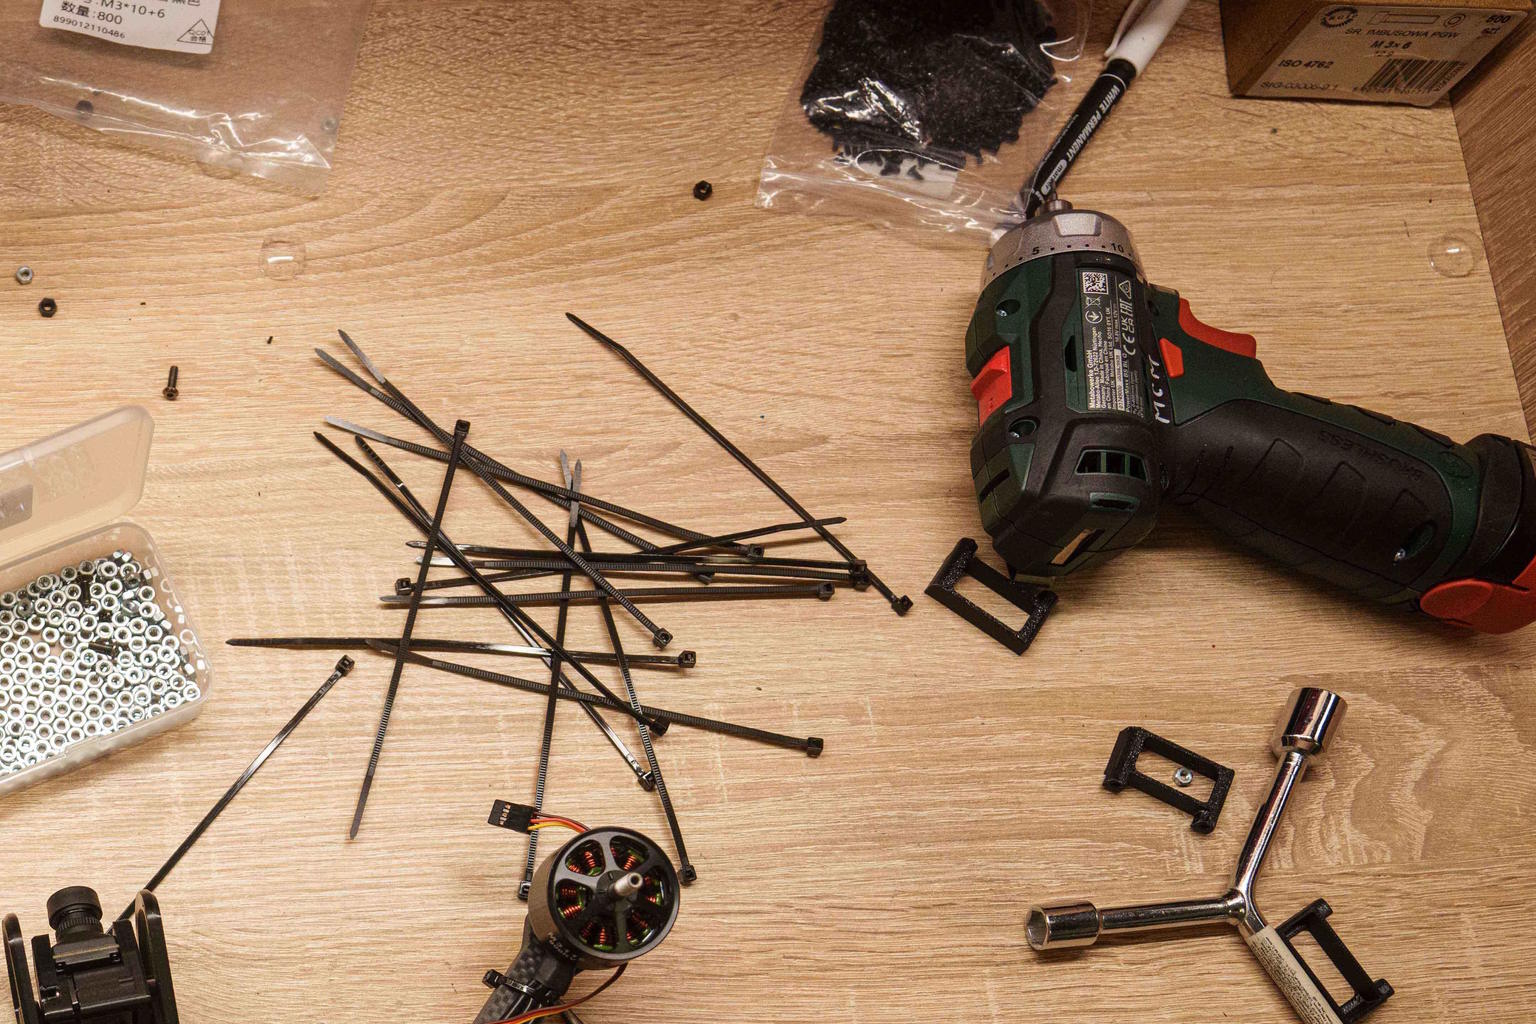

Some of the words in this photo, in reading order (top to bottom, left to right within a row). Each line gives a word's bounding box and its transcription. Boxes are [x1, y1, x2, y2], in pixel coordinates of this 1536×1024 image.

[52, 15, 126, 39] 899012110486
[1278, 58, 1302, 69] ISO
[1303, 60, 1335, 70] 4762
[1100, 84, 1121, 114] WHITE
[1066, 110, 1102, 162] PERMANENT
[1032, 246, 1040, 256] 5
[1112, 243, 1125, 254] 10
